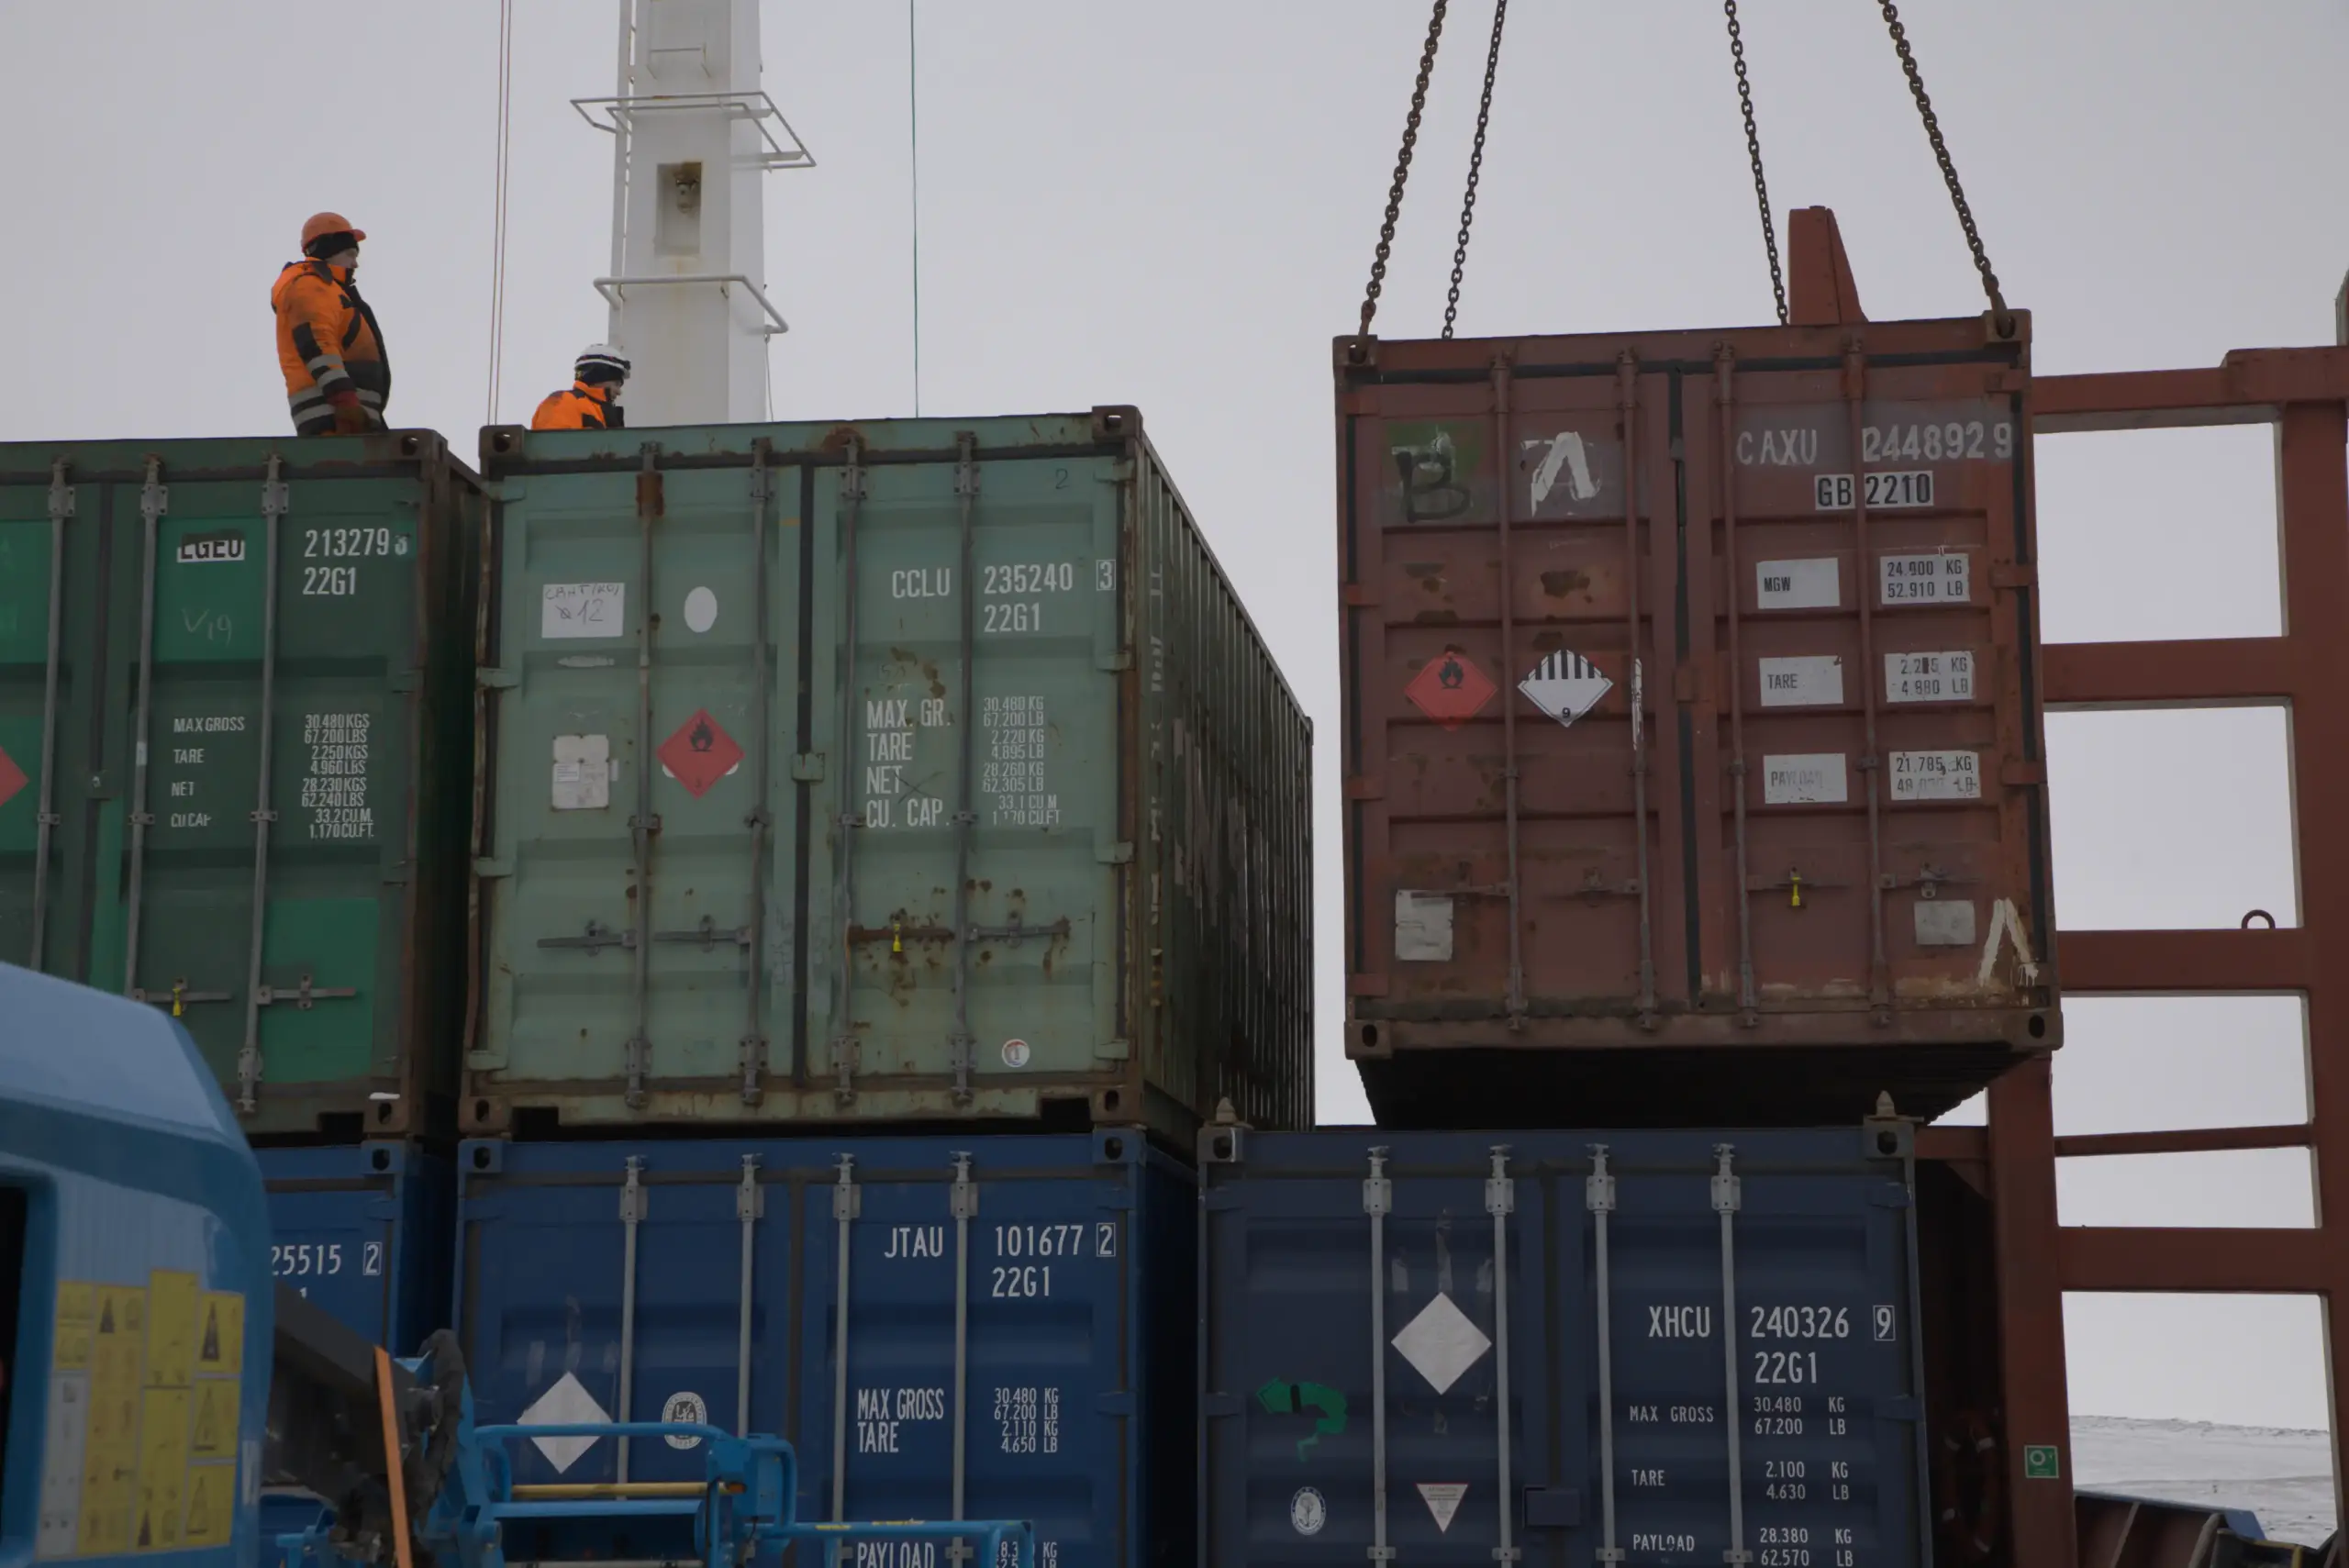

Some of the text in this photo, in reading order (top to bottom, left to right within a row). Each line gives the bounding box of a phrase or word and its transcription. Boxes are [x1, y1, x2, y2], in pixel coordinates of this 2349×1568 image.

[1736, 421, 2012, 465] CAXU 244892 9
[1055, 468, 1069, 489] 2
[1817, 473, 1932, 507] GB 2210
[304, 528, 389, 557] 213279
[1946, 560, 1963, 575] KG
[302, 567, 356, 595] 22G1
[892, 561, 1114, 598] CCLU 235240 3
[1764, 577, 1791, 593] MGW
[1887, 580, 1963, 598] 52.910 LB
[984, 603, 1040, 632] 22G1
[1901, 657, 1967, 674] 2.25 KG
[1767, 673, 1798, 690] TARE
[1953, 678, 1968, 694] LB
[984, 695, 1044, 711] 30.480 KG
[866, 698, 951, 729] MAX. GR.
[984, 711, 1044, 727] 67.200 LB
[1562, 707, 1570, 717] 9
[991, 729, 1044, 745] 2.220 KG
[867, 732, 914, 762] TARE
[991, 744, 1044, 760] 4.895 LB
[173, 749, 206, 763] TARE
[984, 762, 1044, 777] 28.260 KG
[866, 765, 903, 794] NET
[983, 777, 1044, 793] 62.305 LB
[171, 781, 195, 796] NET
[866, 798, 950, 828] CU. CAP.
[884, 1224, 1114, 1258] JTAU 101677 2
[364, 1243, 380, 1274] 2
[992, 1265, 1050, 1296] 22G1
[1648, 1306, 1893, 1340] XHCU 240326 9
[1754, 1351, 1817, 1384] 22G1
[857, 1387, 944, 1419] MAX GROSS
[994, 1388, 1059, 1403] 30.480 KG
[1753, 1396, 1845, 1412] 30.480 KG
[994, 1405, 1058, 1420] 67.200 LB
[1630, 1406, 1714, 1422] MAX GROSS
[1002, 1421, 1058, 1436] 2.110 KG
[1754, 1418, 1846, 1435] 67.200 LB
[857, 1421, 899, 1452] TARE
[1001, 1437, 1058, 1452] 4.650 LB
[1631, 1469, 1665, 1486] TARE
[1765, 1461, 1848, 1478] 2.100 KG
[1765, 1484, 1849, 1500] 4.630 LB
[1632, 1533, 1695, 1551] PAYLOAD
[1760, 1528, 1853, 1544] 28.380 KG
[1042, 1541, 1058, 1558] KG
[1761, 1550, 1854, 1566] 62.570 LB
